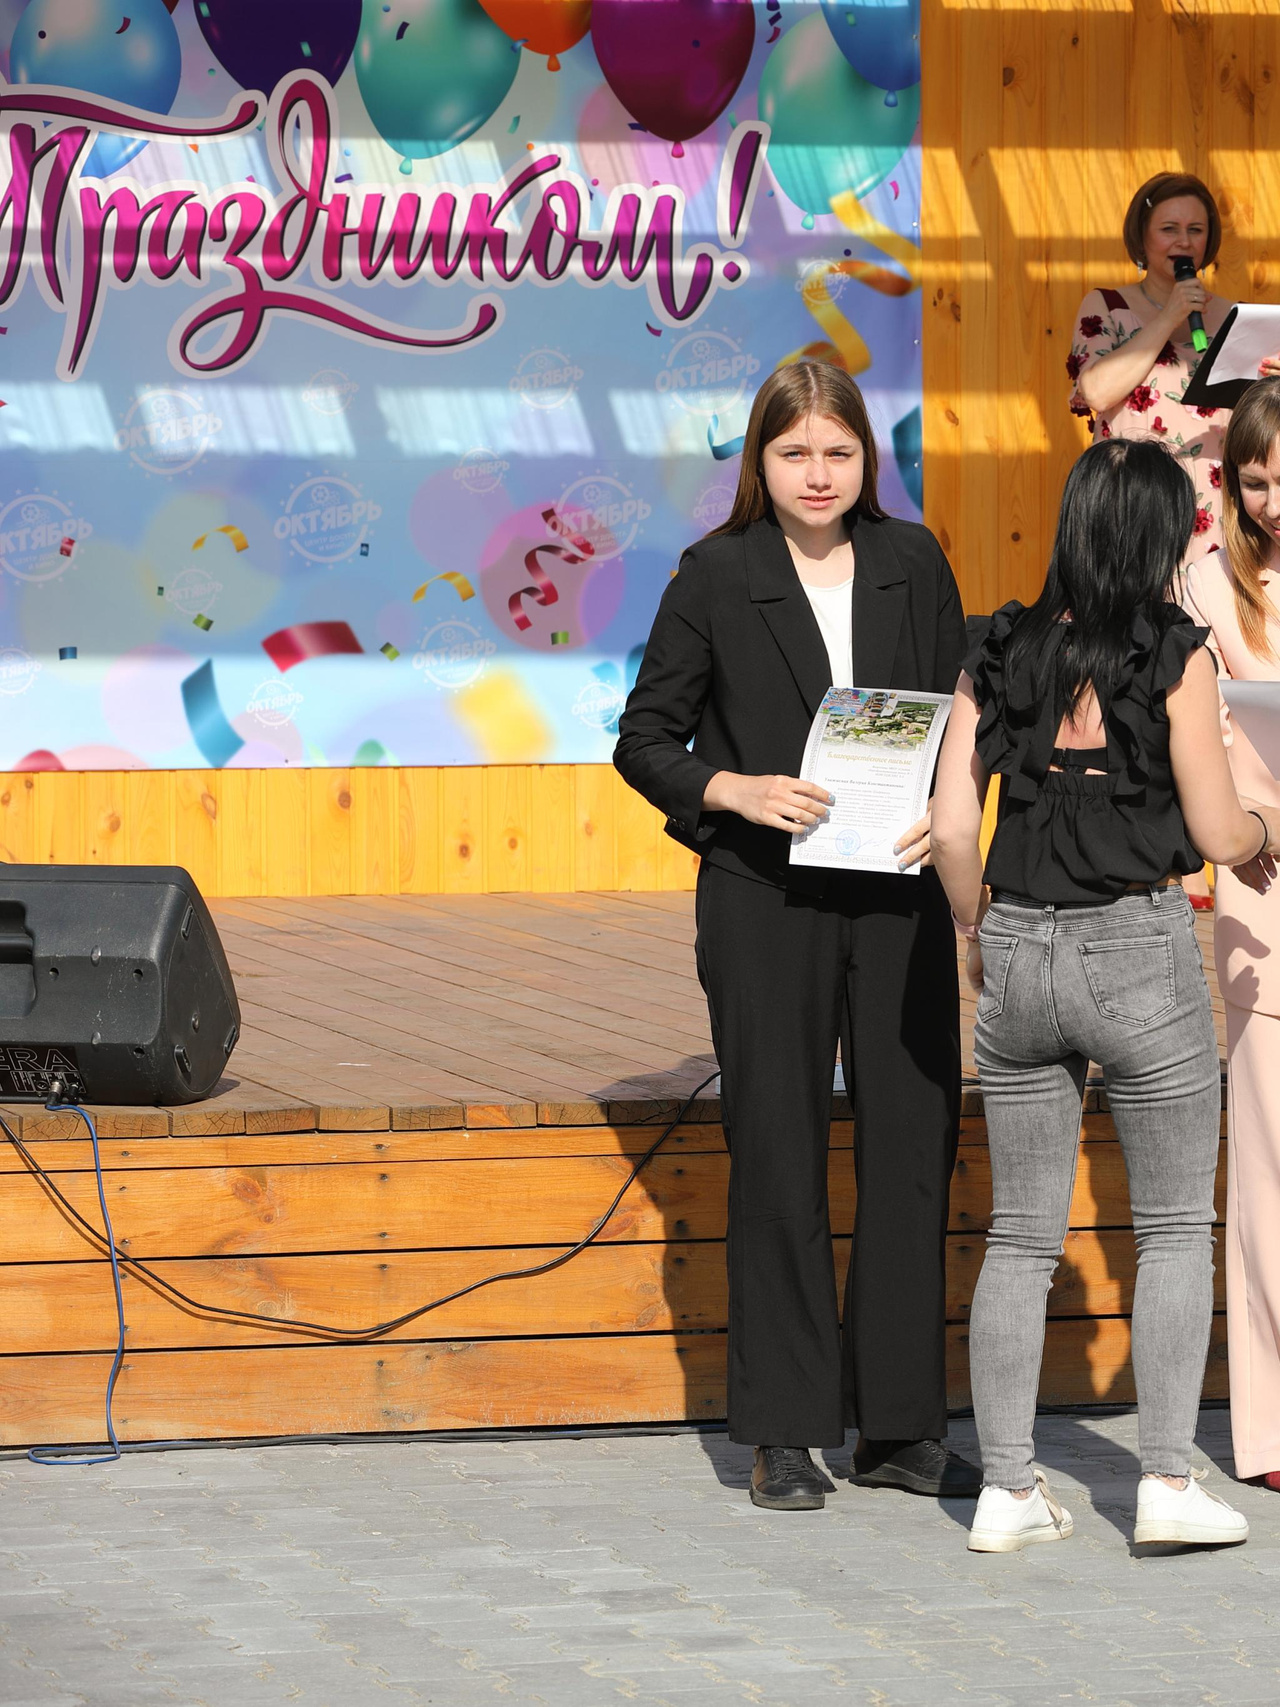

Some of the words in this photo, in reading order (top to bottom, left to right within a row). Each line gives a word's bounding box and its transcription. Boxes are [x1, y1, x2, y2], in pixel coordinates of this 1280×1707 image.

[794, 270, 851, 293] ОКТЯБРЬ
[508, 365, 585, 392] ОКТЯБРЬ
[655, 352, 761, 392] ОКТЯБРЬ
[301, 383, 361, 403] ОКТЯБРЬ
[113, 412, 223, 451] ОКТЯБРЬ
[452, 460, 510, 481] ОКТЯБРЬ
[272, 500, 383, 540] ОКТЯБРЬ
[545, 497, 652, 538] ОКТЯБРЬ
[692, 500, 733, 518] ОКТЯБ
[0, 516, 94, 556] КТЯБРЬ
[165, 581, 224, 602] ОКТЯБРЬ
[412, 637, 497, 670] ОКТЯБРЬ
[0, 660, 42, 679] ТЯБРЬ
[246, 691, 304, 713] ОКТЯБРЬ
